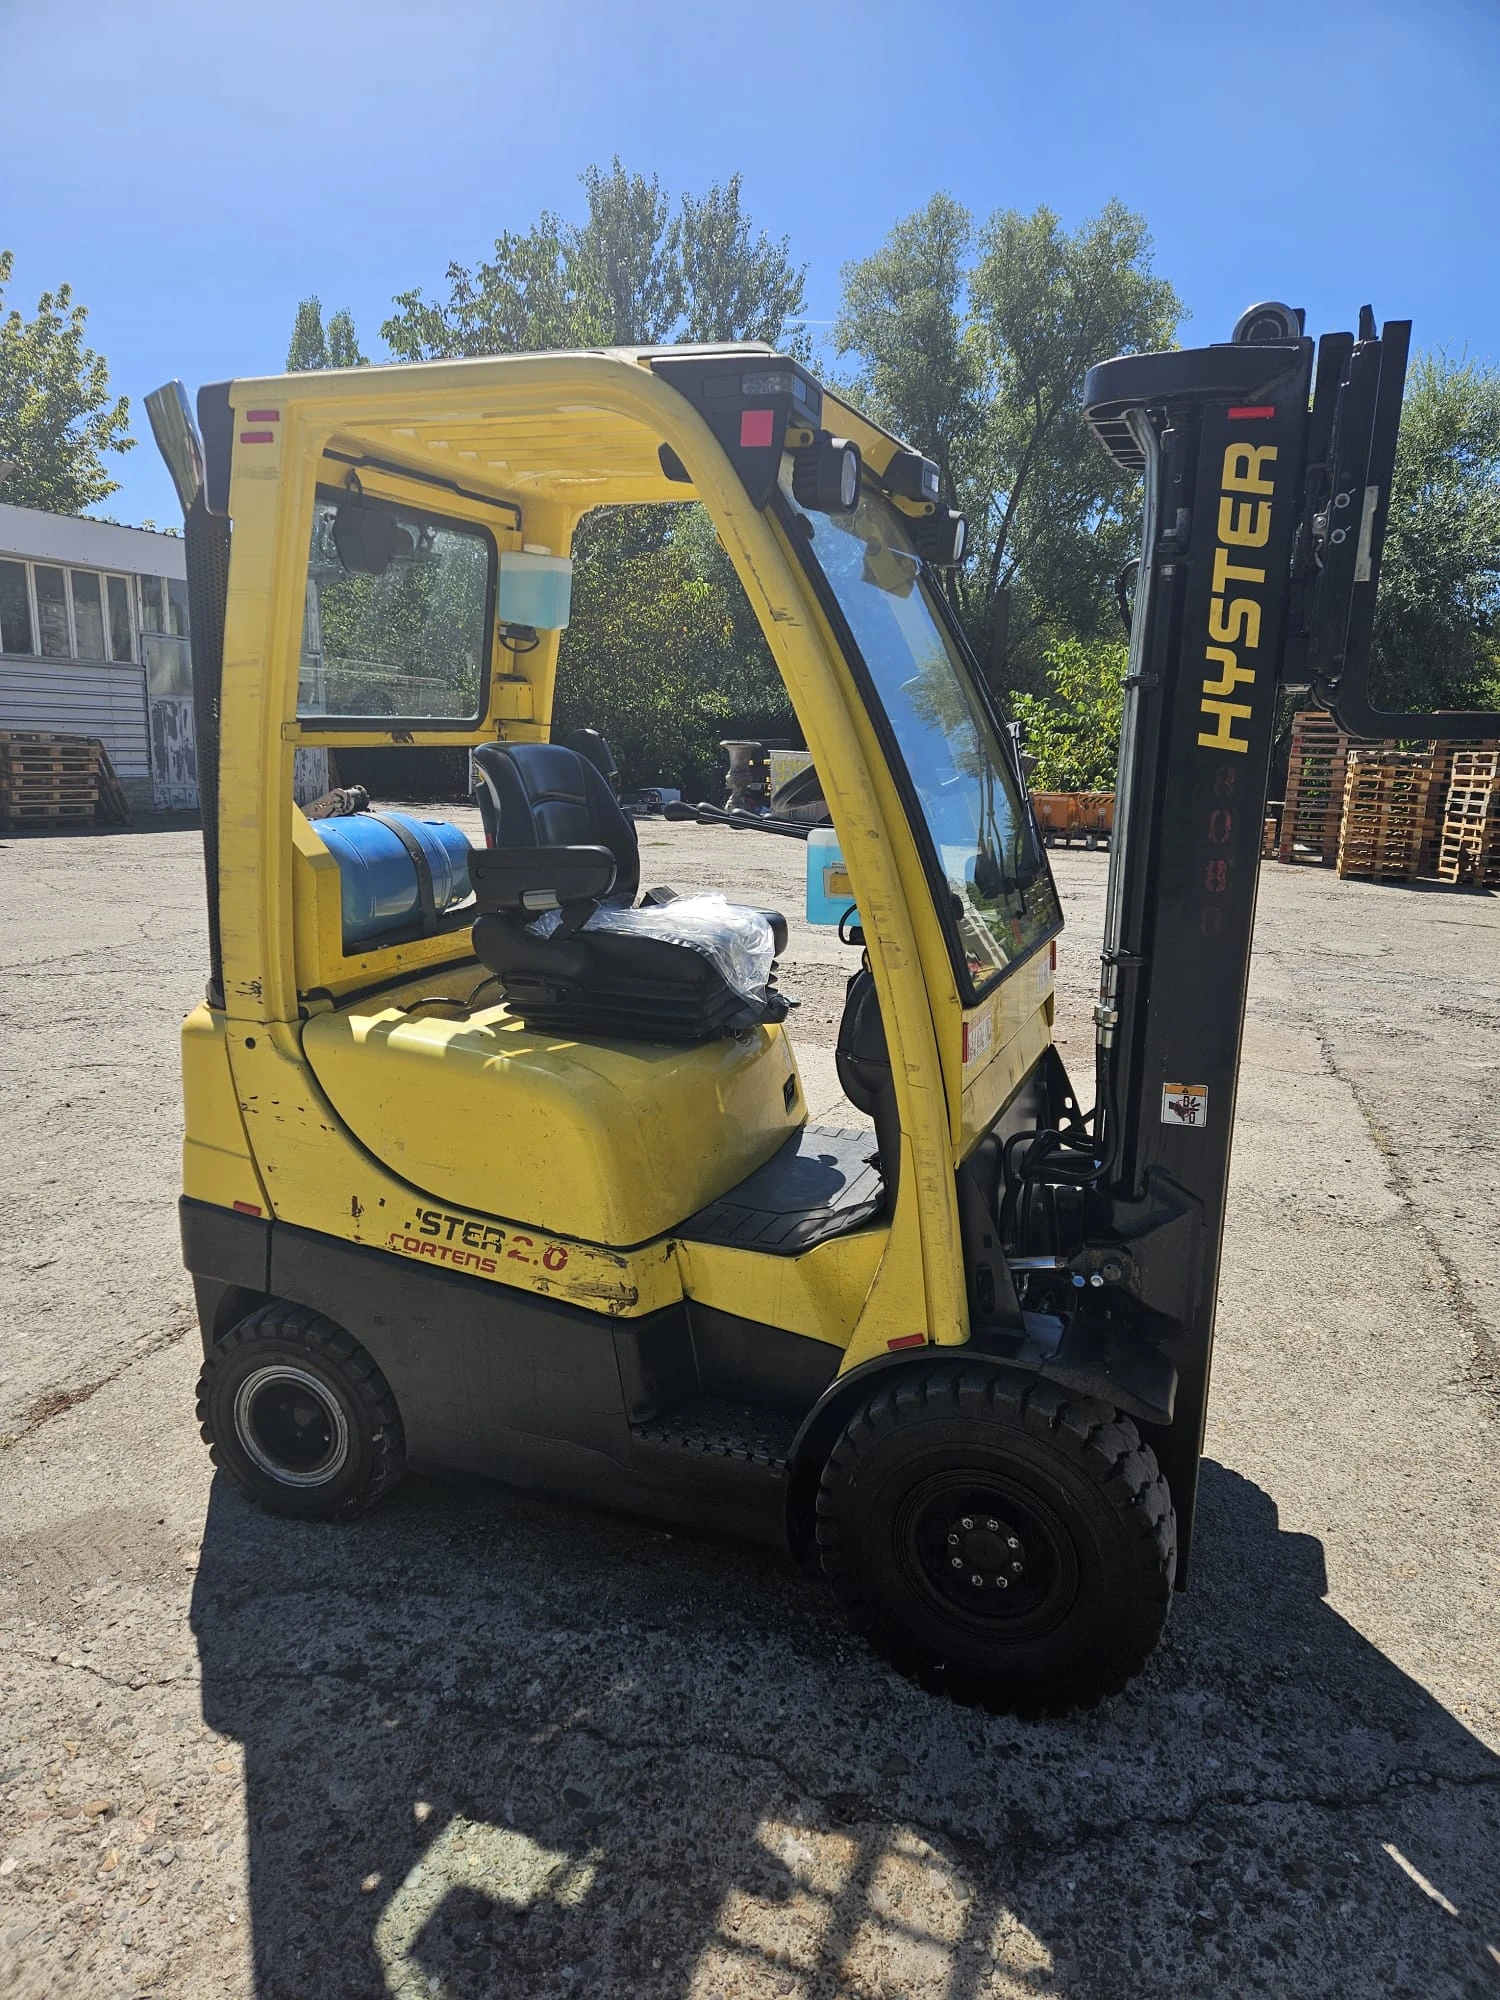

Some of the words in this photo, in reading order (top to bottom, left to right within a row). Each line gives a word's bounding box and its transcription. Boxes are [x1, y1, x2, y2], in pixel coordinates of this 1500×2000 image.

[1197, 442, 1278, 753] HYSTER
[402, 1207, 506, 1254] STER
[507, 1236, 569, 1271] 2.0
